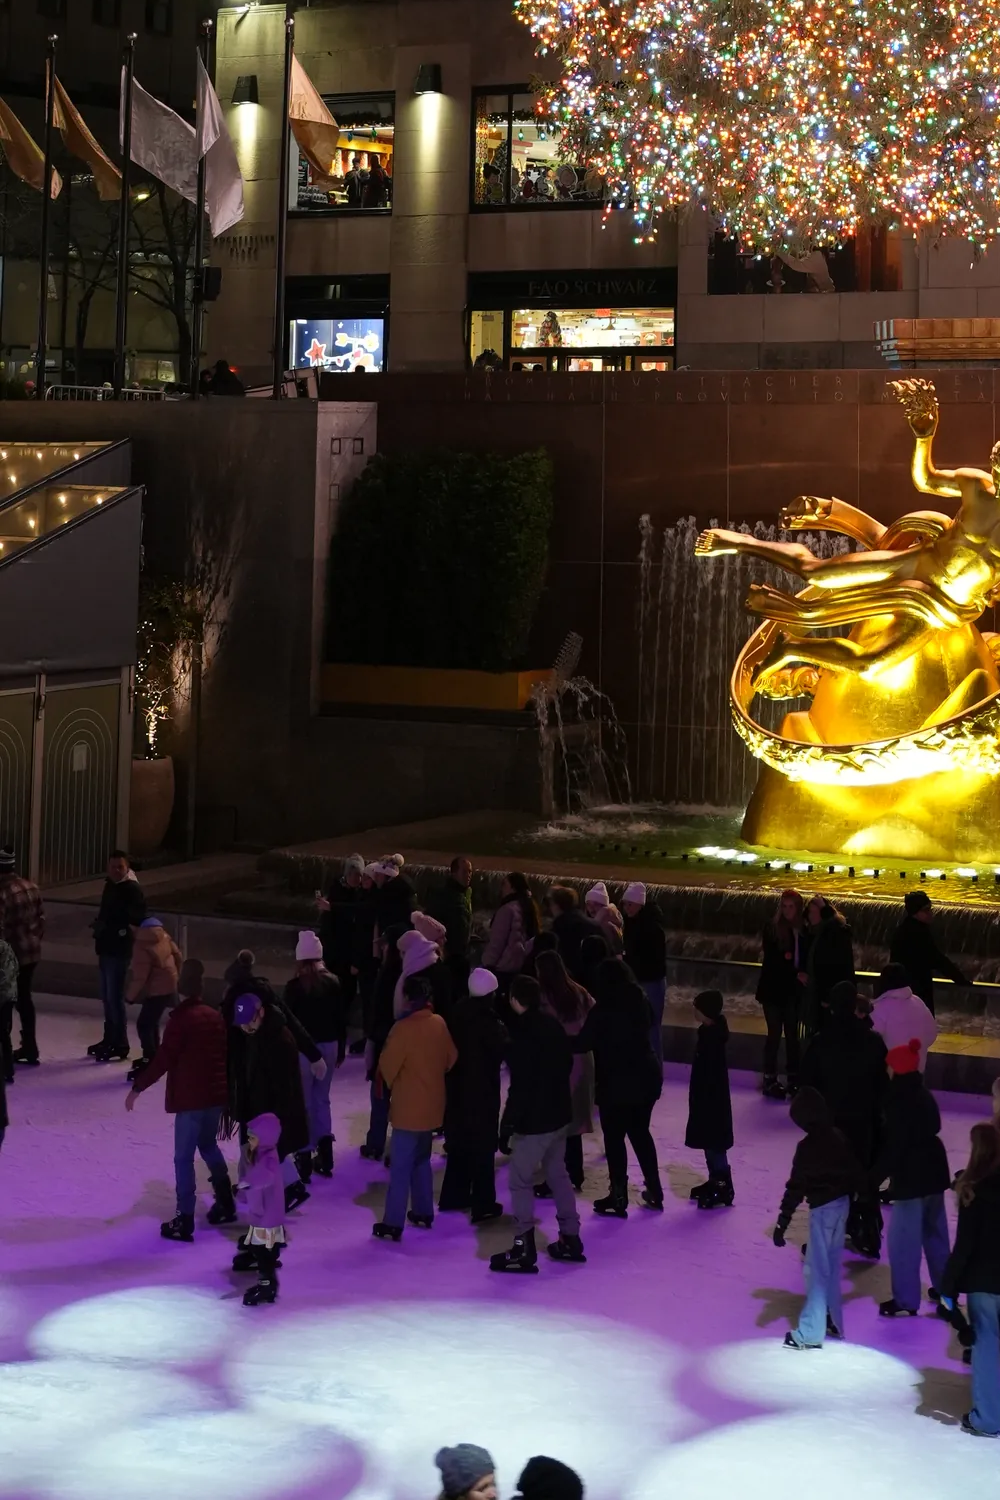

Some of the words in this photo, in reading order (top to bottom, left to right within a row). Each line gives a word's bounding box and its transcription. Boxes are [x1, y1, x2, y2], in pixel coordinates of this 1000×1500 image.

[574, 279, 658, 296] SCHWARZ
[698, 376, 845, 388] TEACHER
[812, 391, 844, 402] TO
